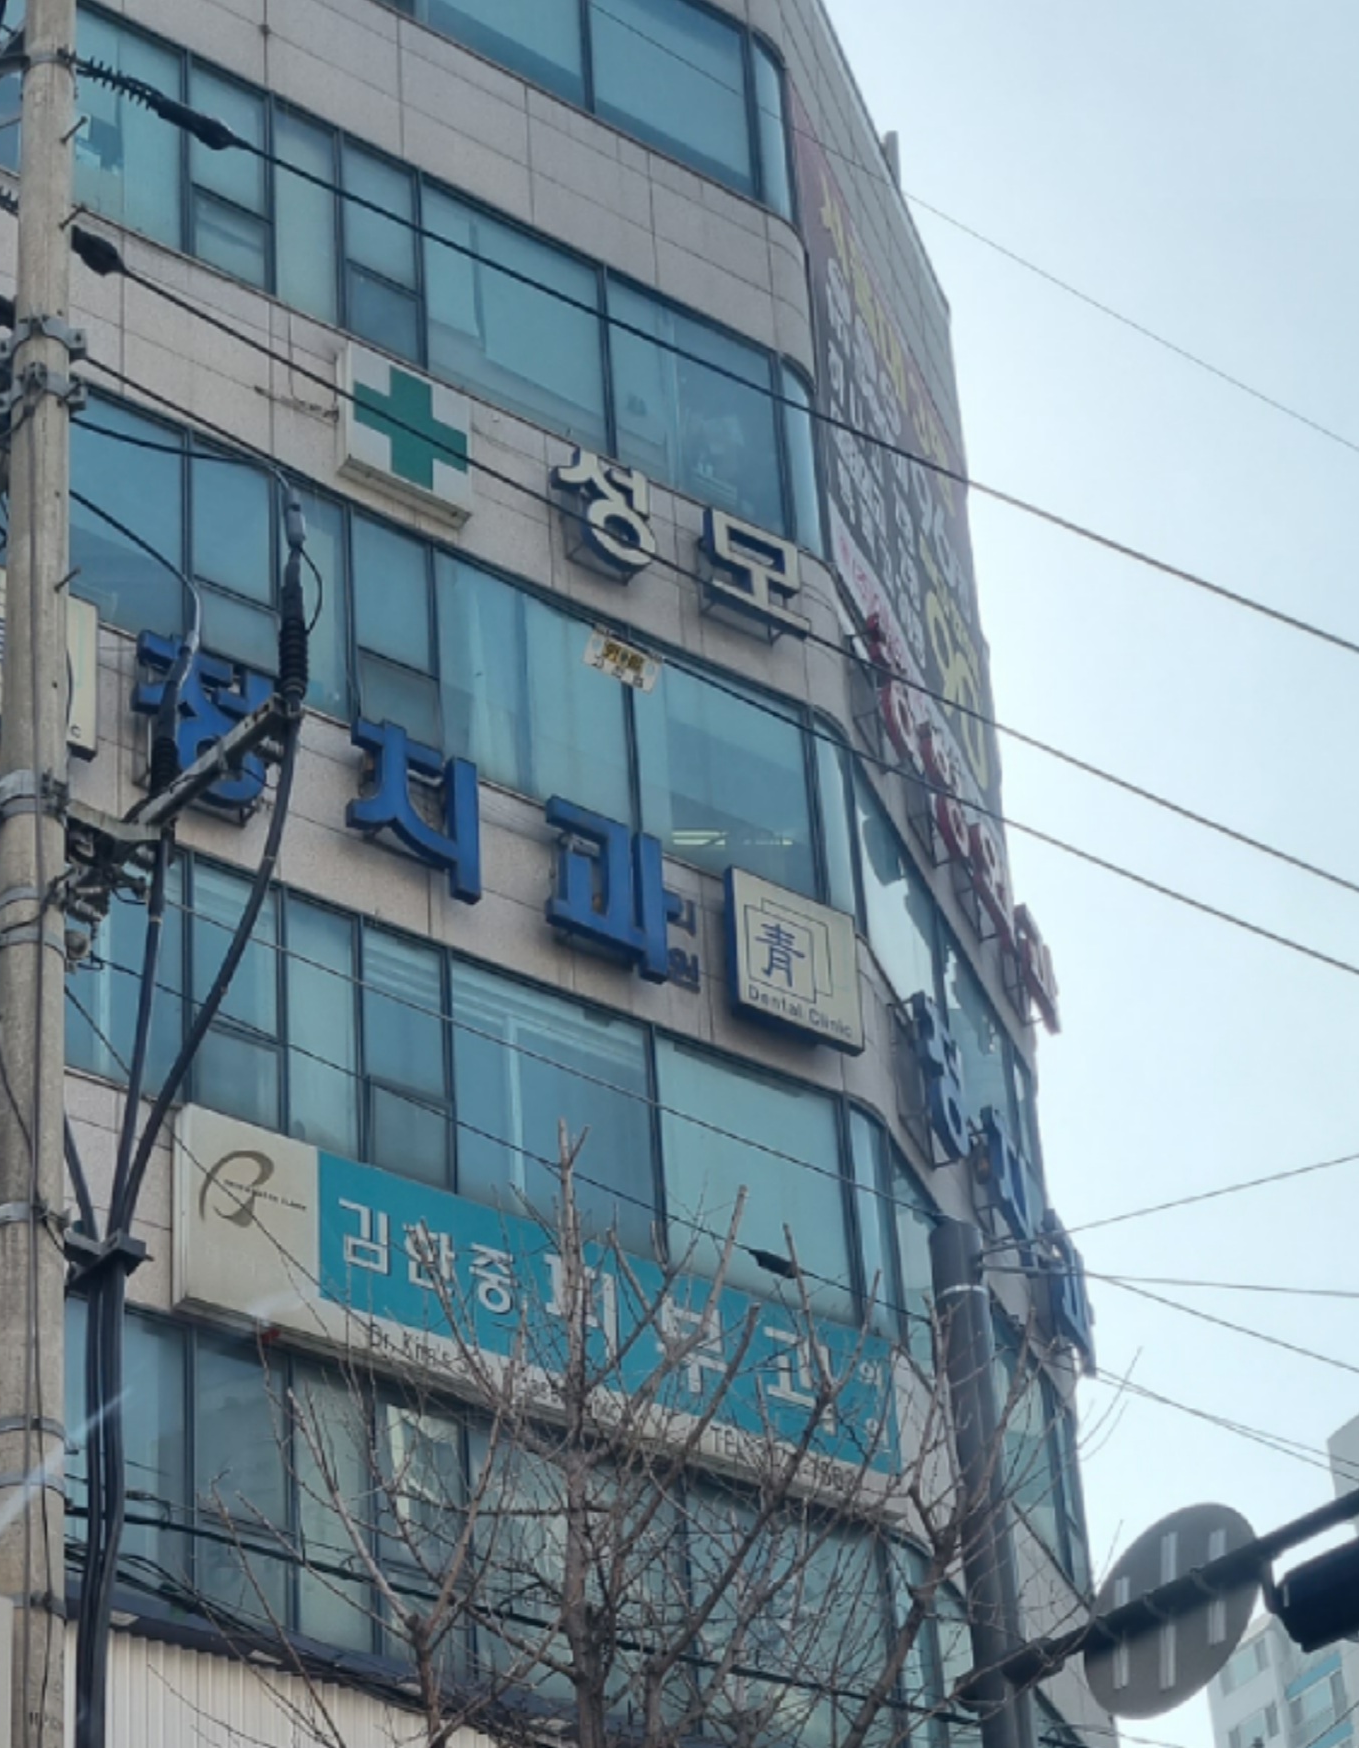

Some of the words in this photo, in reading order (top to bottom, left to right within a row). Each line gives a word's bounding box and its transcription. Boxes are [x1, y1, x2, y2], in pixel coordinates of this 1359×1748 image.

[553, 446, 810, 640] 성모
[747, 983, 803, 1019] Dental
[808, 1007, 852, 1038] Clinic
[754, 923, 806, 988] 青
[544, 1253, 835, 1437] 피부과
